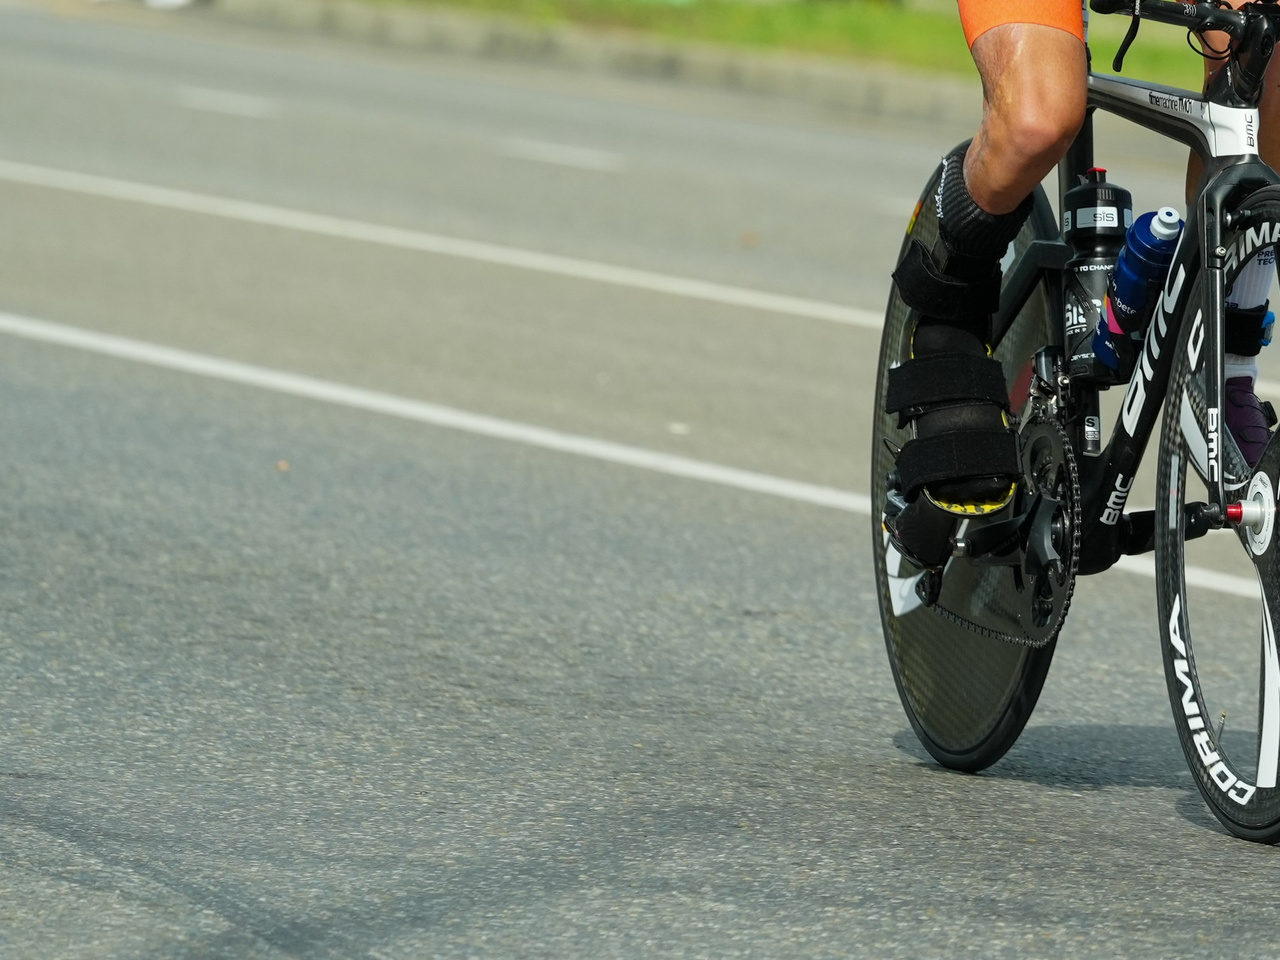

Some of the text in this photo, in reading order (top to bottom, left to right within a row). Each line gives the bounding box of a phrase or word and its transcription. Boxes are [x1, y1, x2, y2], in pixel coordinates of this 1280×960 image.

[1244, 113, 1255, 148] BMC
[1207, 407, 1218, 482] BMC
[1099, 473, 1134, 526] BMC
[1169, 593, 1257, 806] CORIMA
